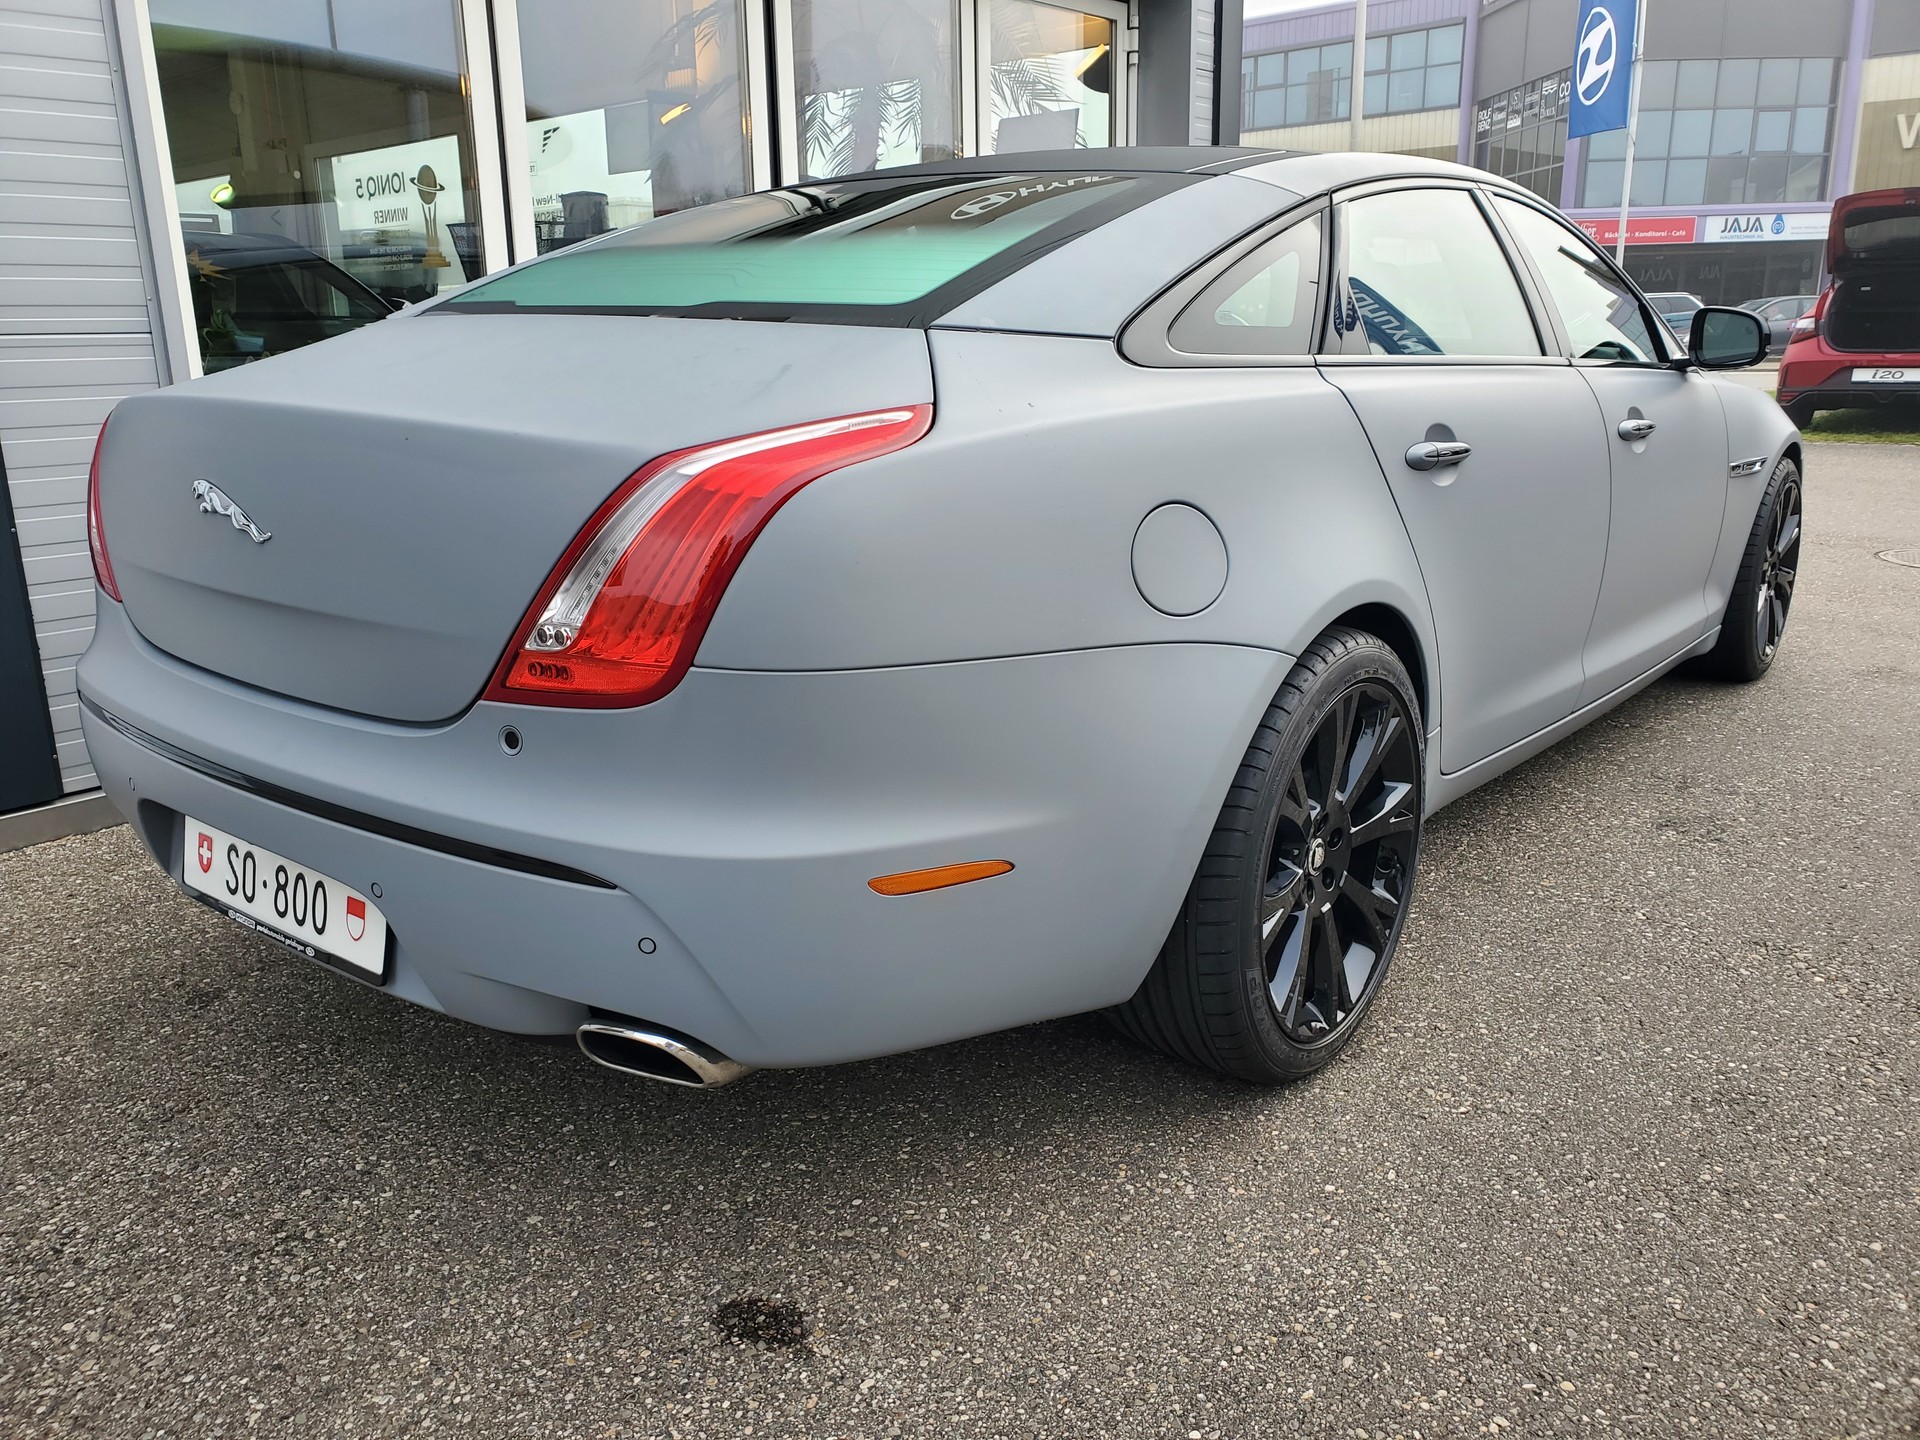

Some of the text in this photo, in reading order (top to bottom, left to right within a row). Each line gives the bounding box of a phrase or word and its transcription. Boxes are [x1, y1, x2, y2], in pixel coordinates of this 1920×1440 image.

[1478, 107, 1492, 121] ROLF
[1477, 119, 1491, 133] BENZ
[1720, 216, 1764, 233] JAJA
